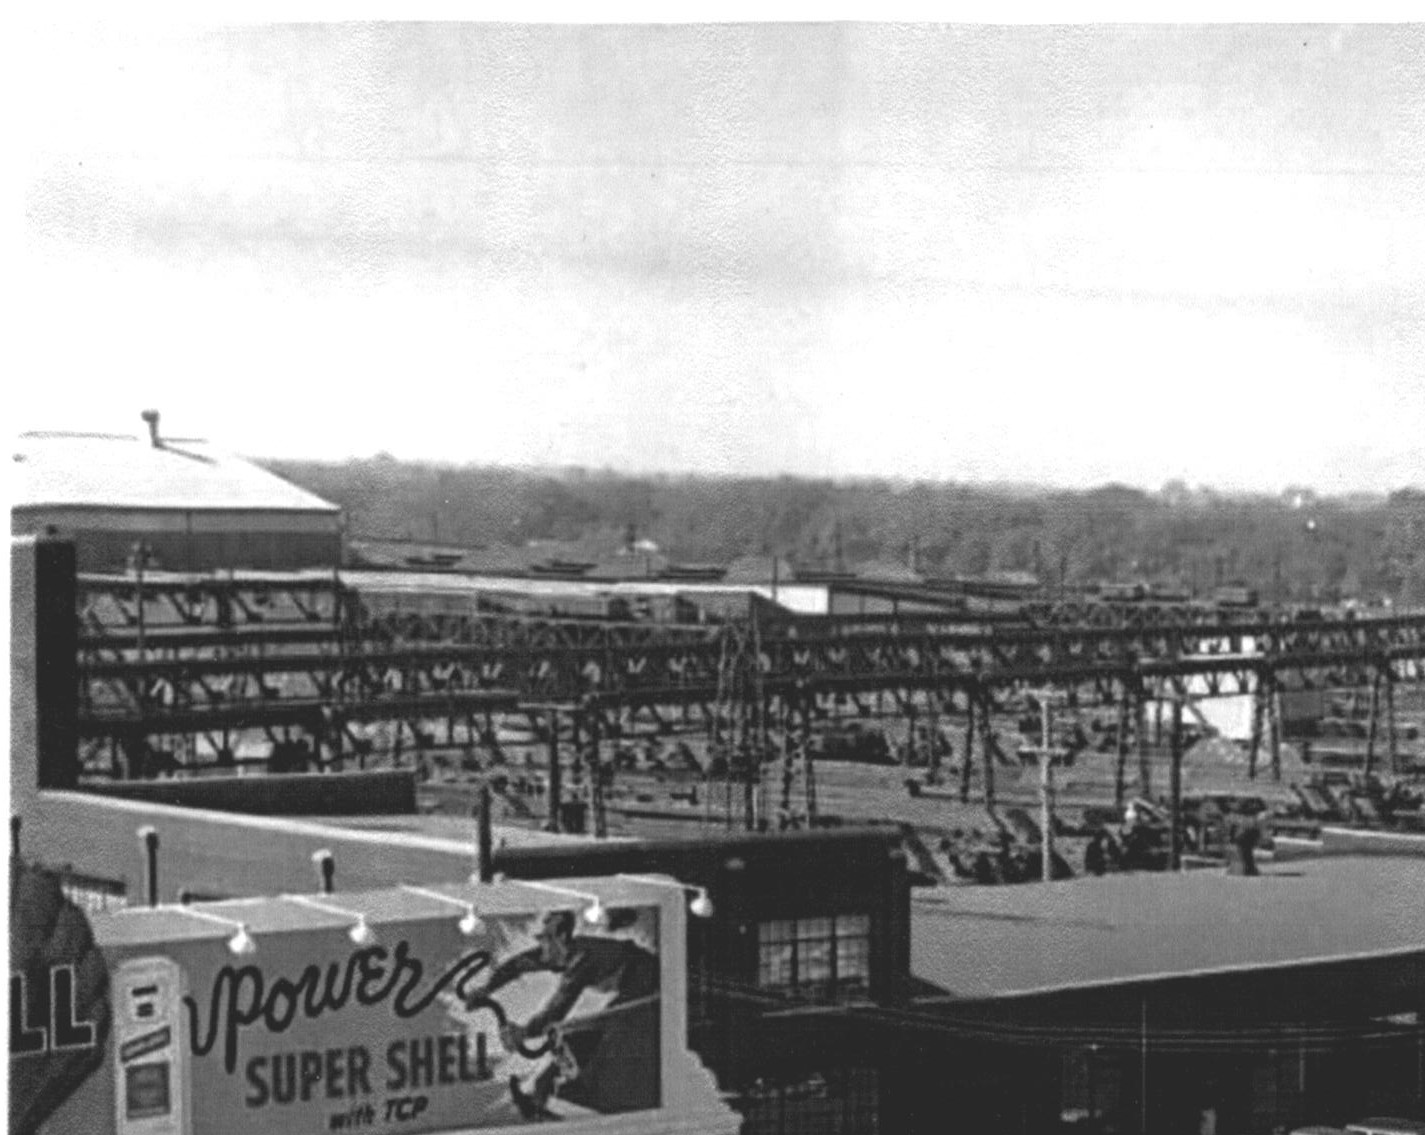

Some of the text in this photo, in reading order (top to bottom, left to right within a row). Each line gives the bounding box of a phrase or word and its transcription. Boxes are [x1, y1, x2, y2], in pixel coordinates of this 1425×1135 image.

[246, 1032, 494, 1108] SUPER SHELL
[329, 1096, 429, 1131] with TCP
